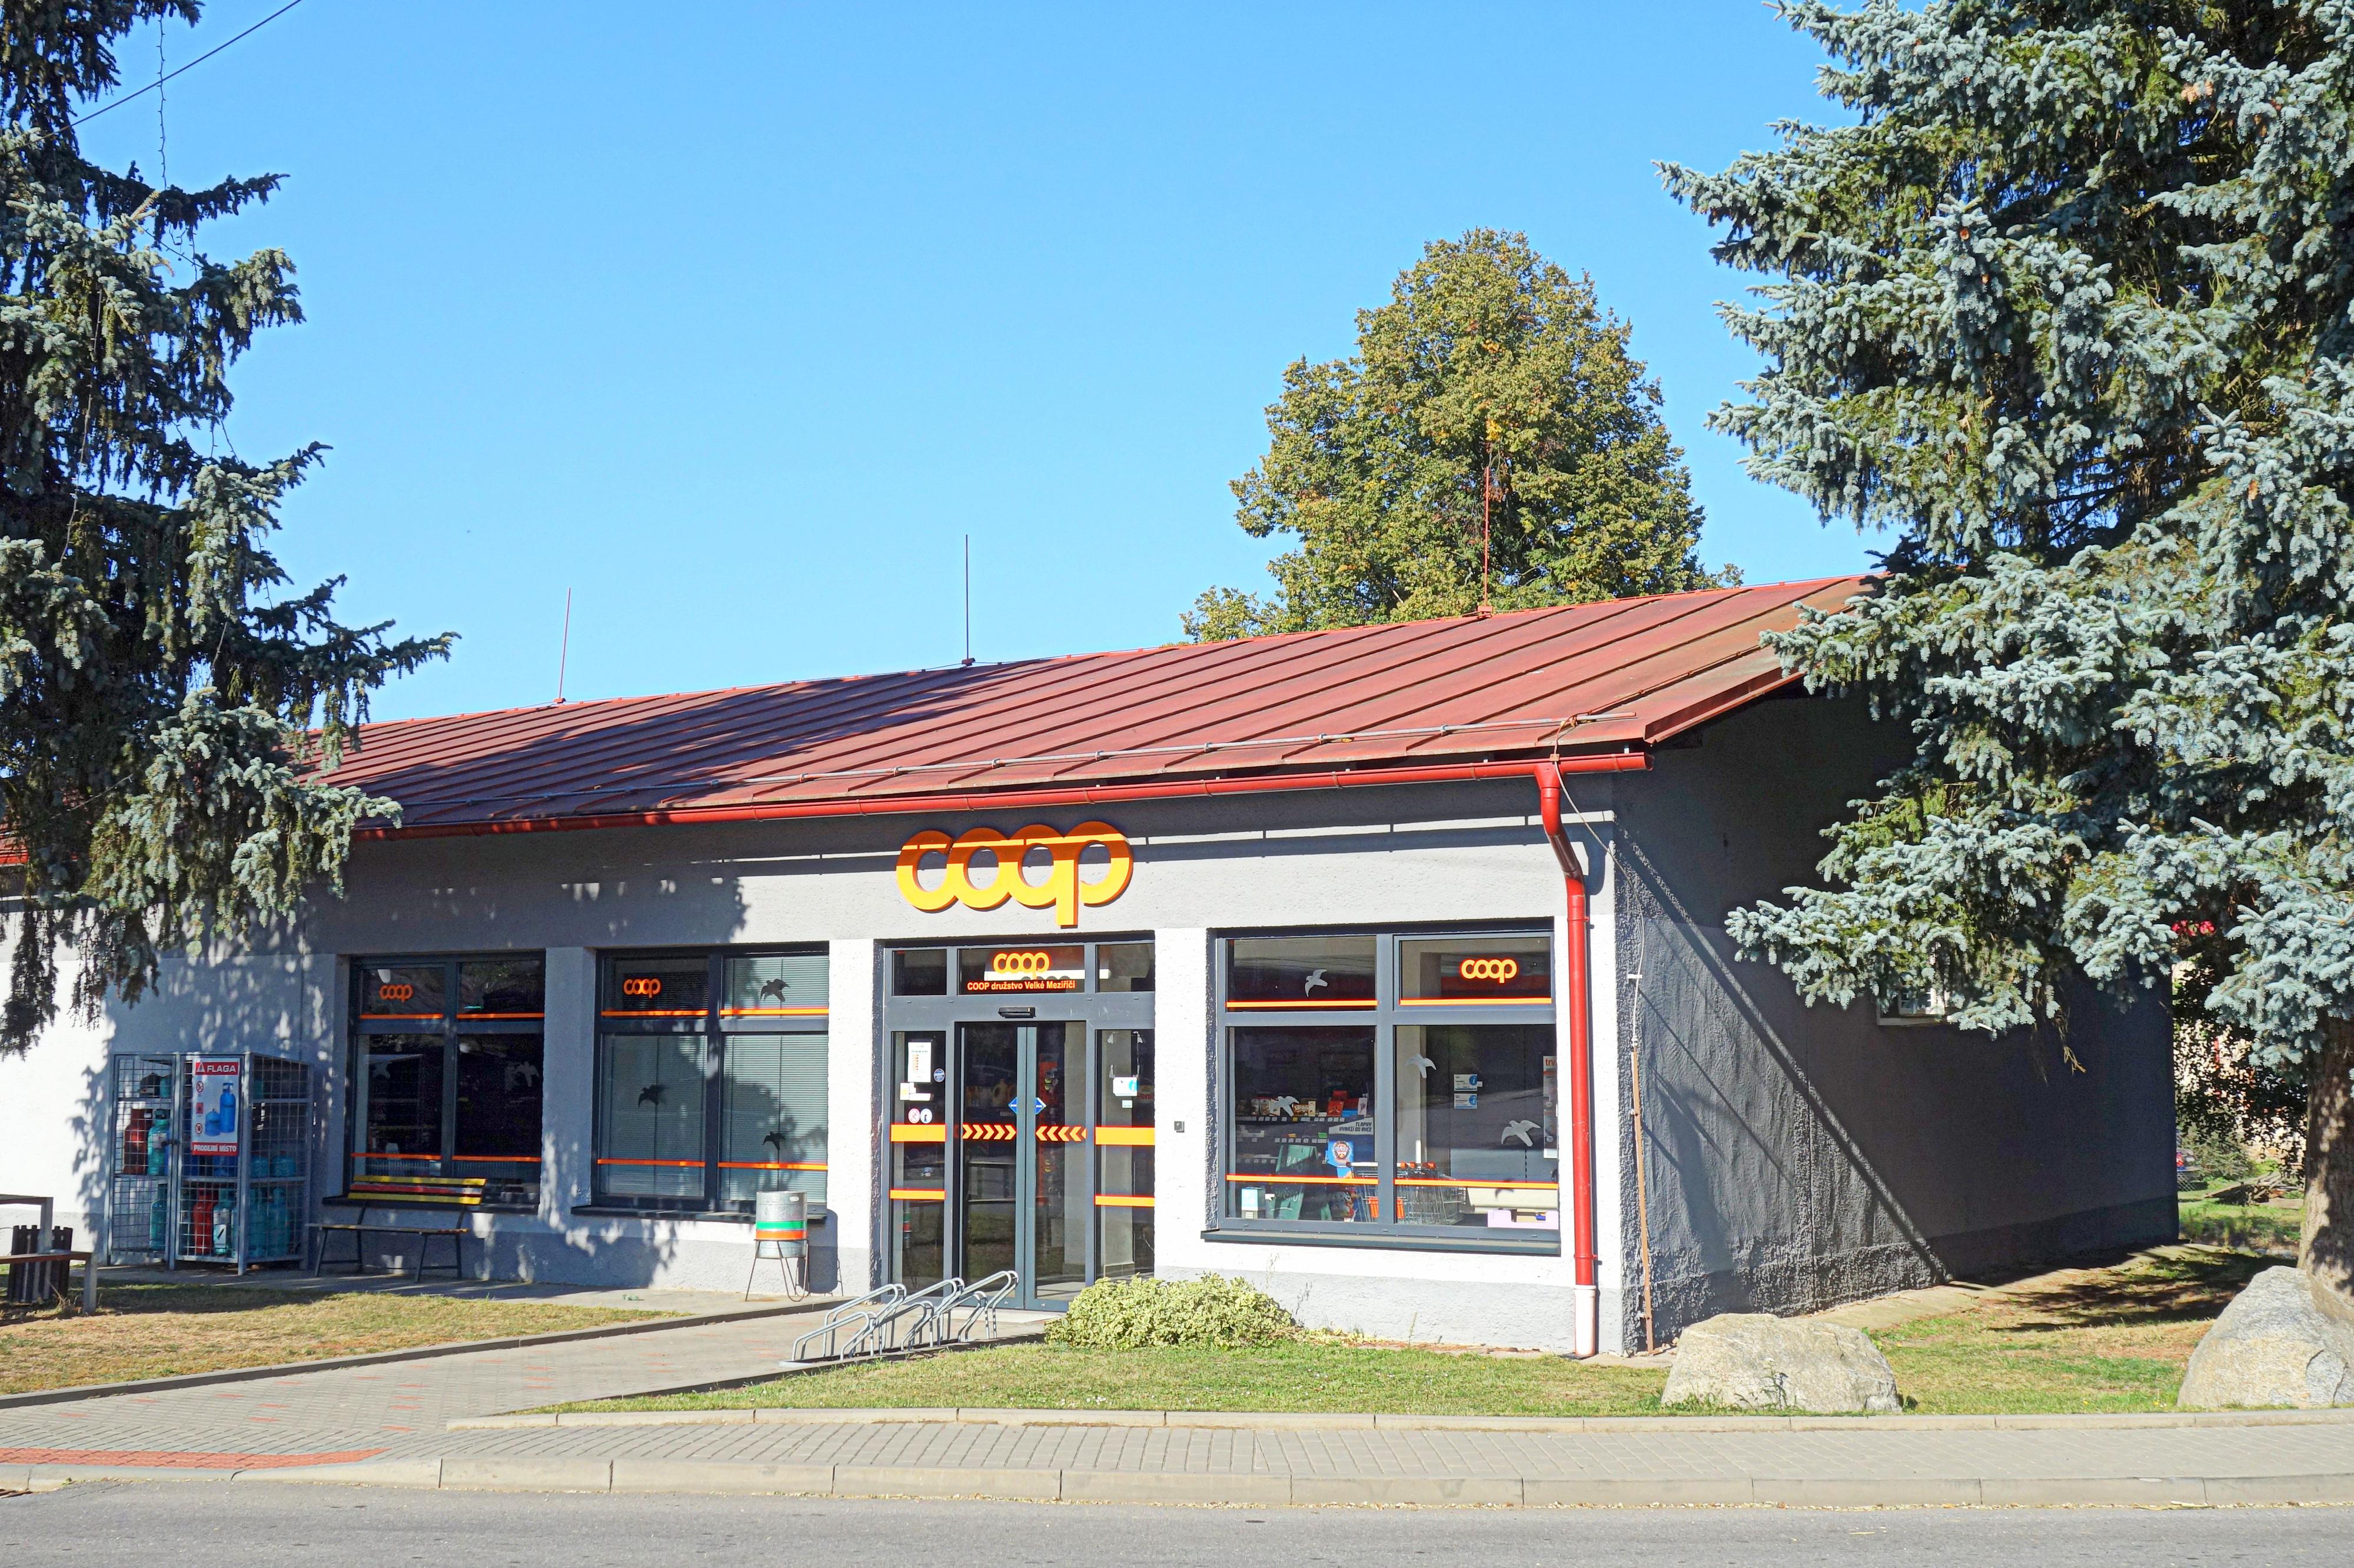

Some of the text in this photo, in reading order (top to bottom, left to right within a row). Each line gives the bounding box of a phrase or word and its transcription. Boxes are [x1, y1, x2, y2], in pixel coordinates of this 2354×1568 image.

[896, 821, 1133, 928] coop
[993, 952, 1050, 980] coop
[1461, 959, 1517, 984] coop
[378, 984, 413, 1003] coop
[623, 978, 660, 998] coop
[967, 980, 1075, 990] COOP družstvo Velké Meziříčí
